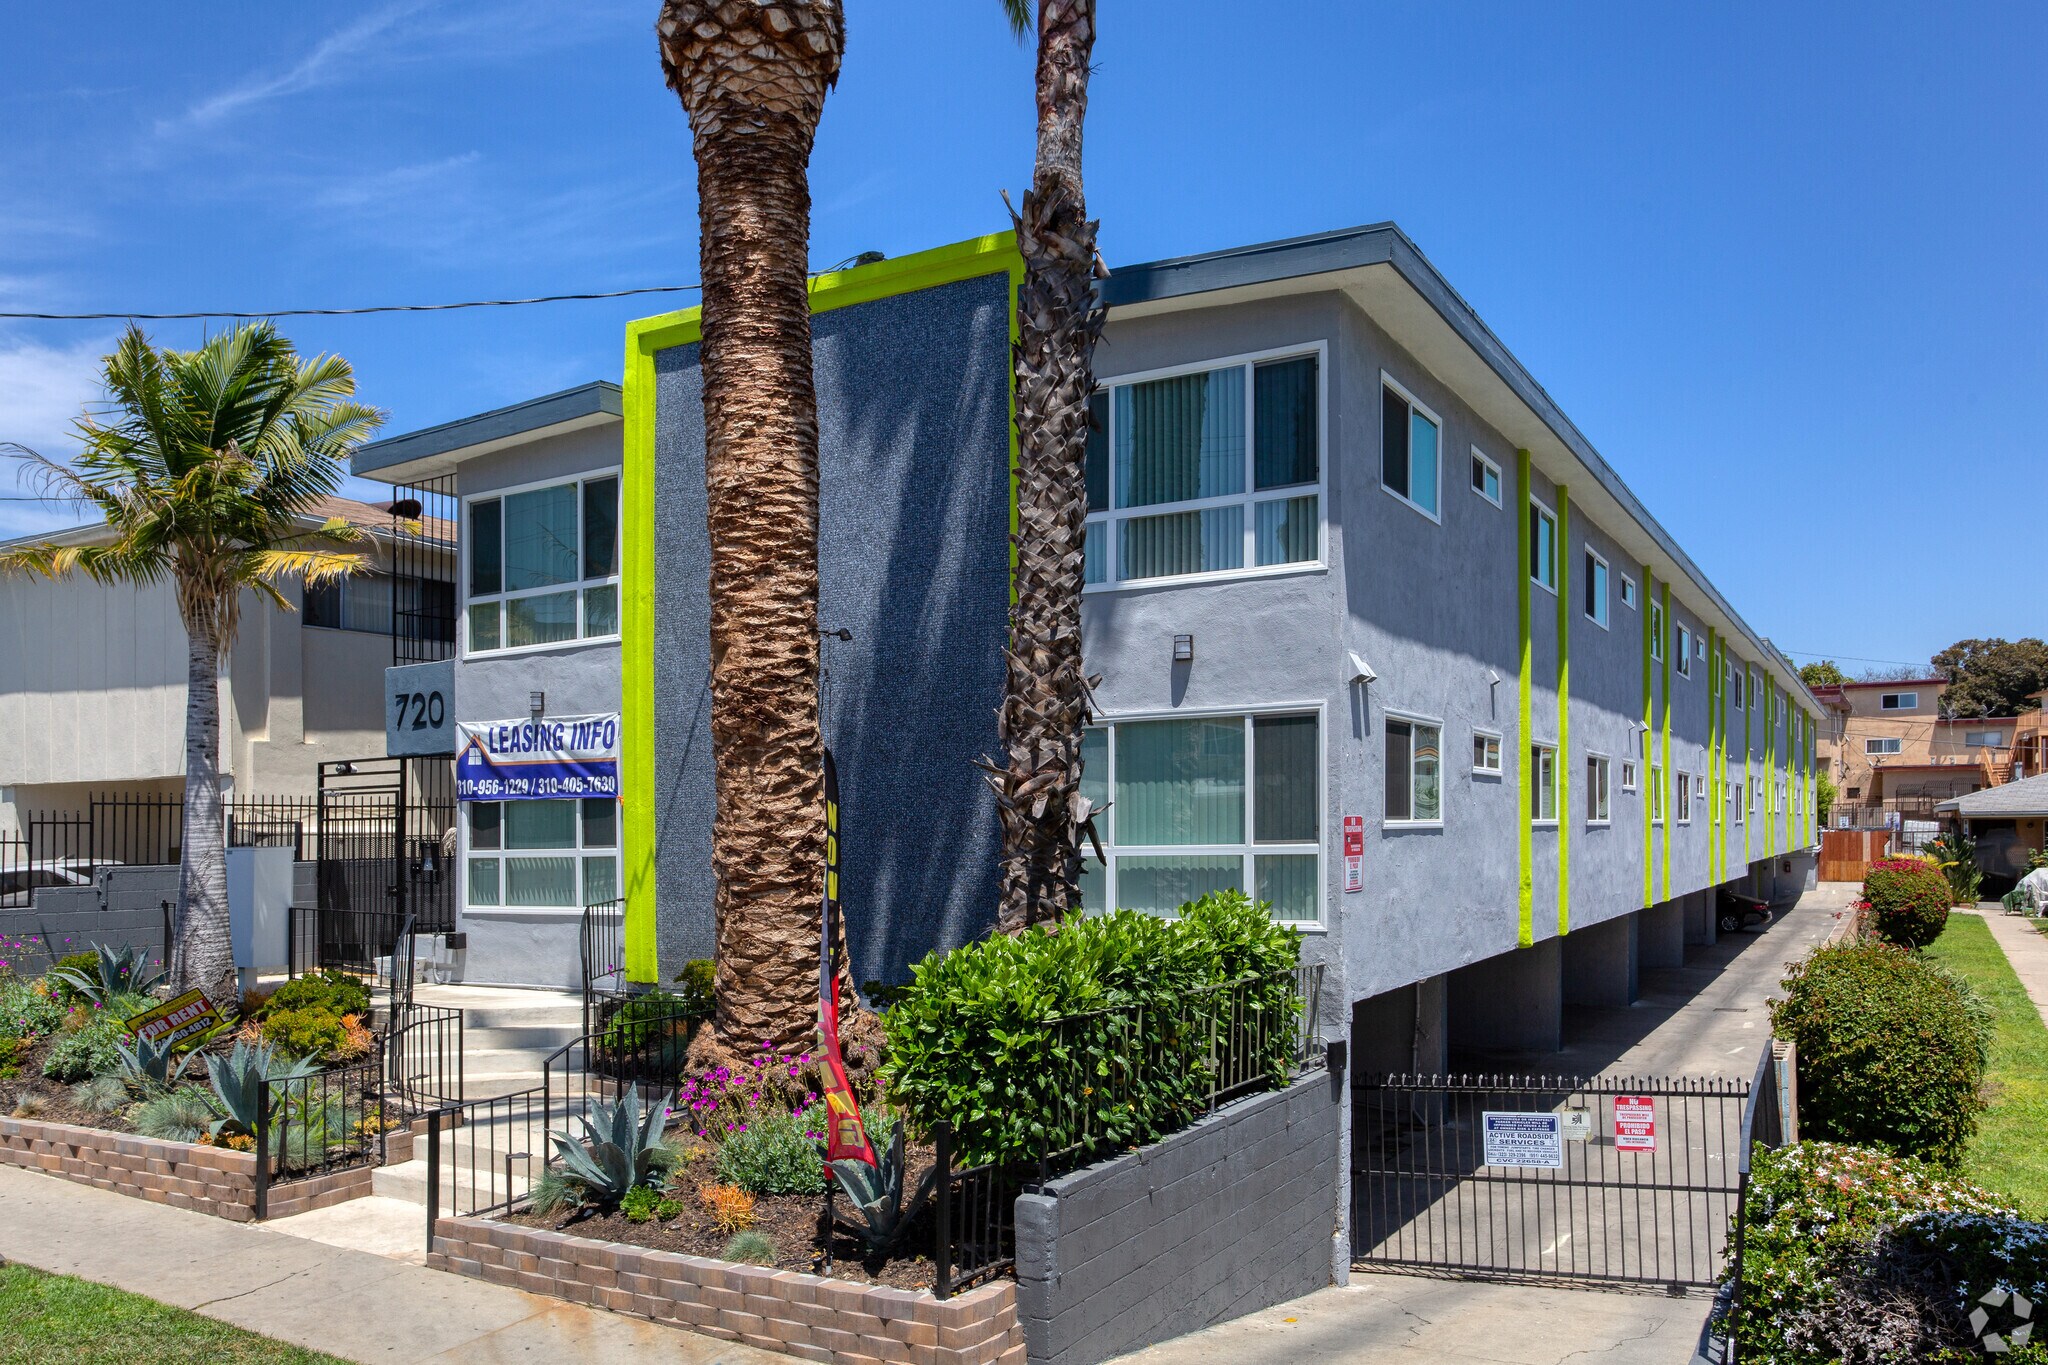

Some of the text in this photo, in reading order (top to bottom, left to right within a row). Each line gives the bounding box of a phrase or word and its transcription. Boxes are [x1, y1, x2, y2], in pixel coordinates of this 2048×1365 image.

[395, 690, 445, 732] 720
[488, 719, 616, 754] LEASING INFO
[458, 779, 528, 795] 310-956-1229
[538, 775, 615, 794] 310-405-7630
[137, 999, 207, 1040] FOR RENT
